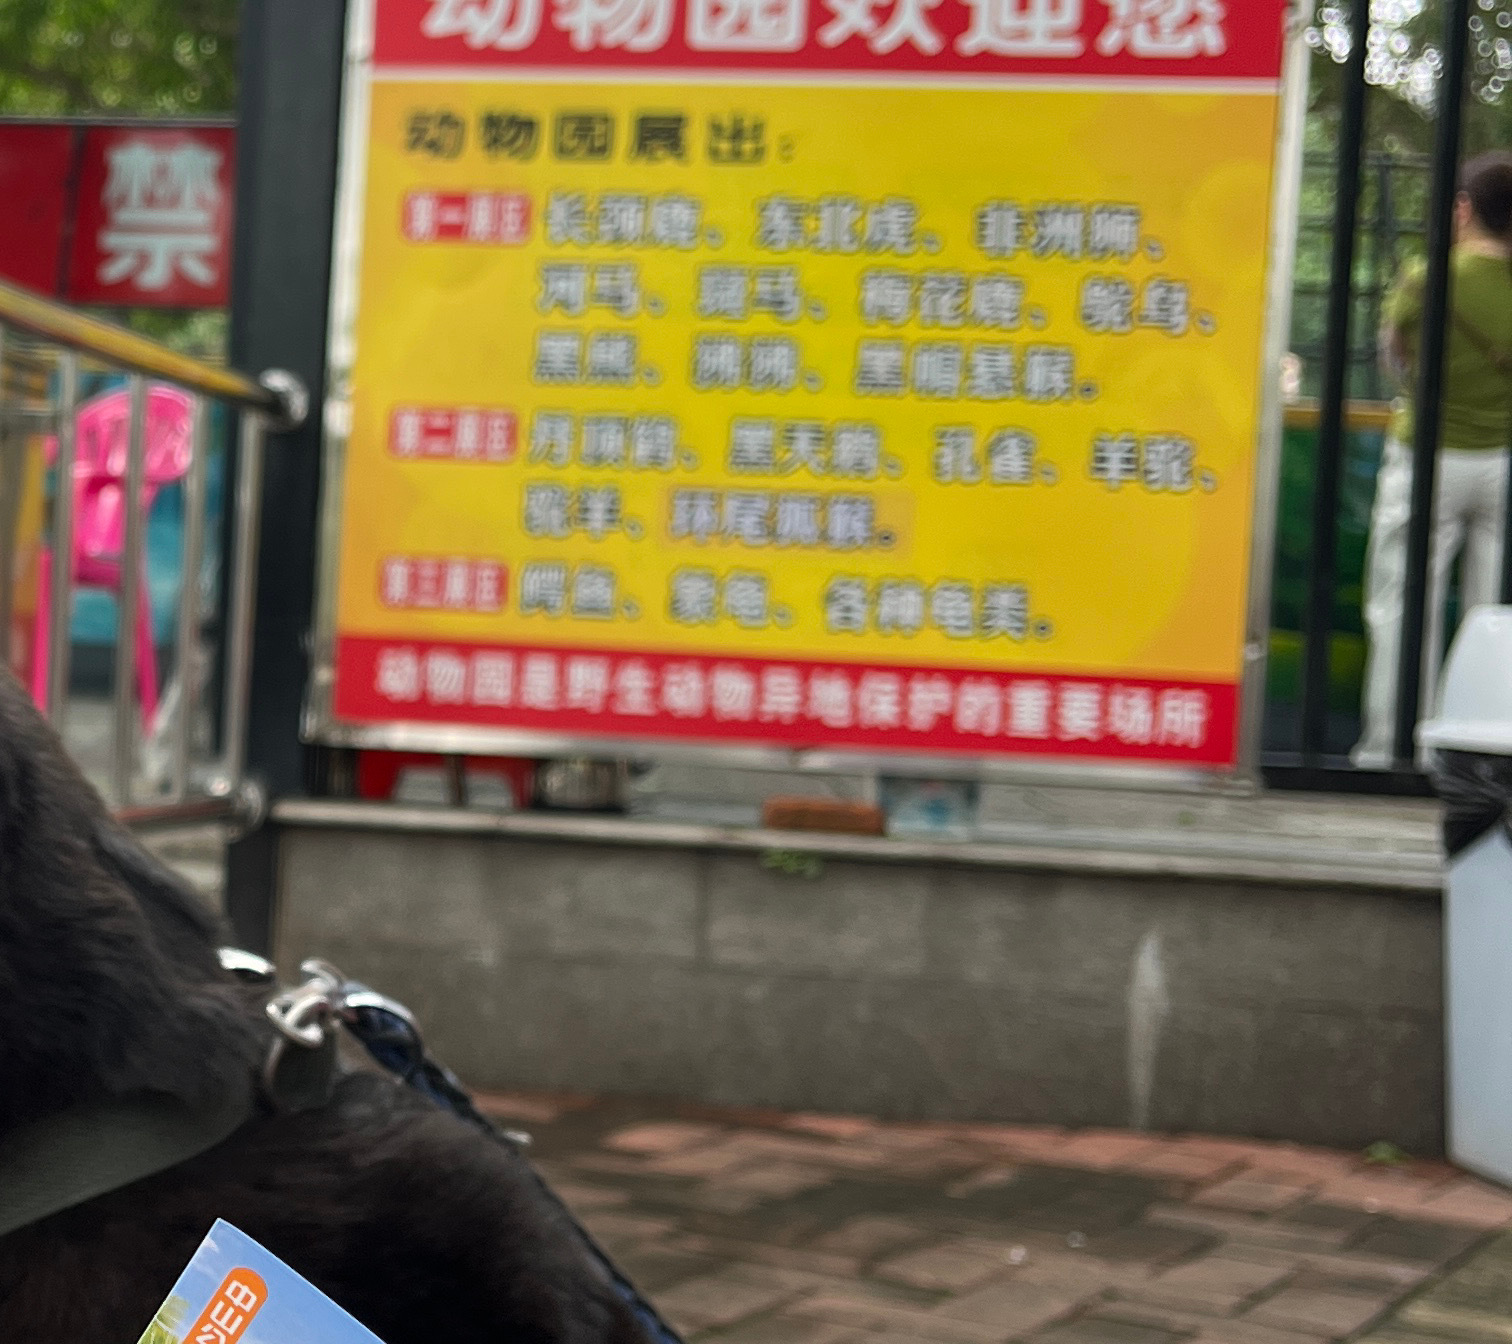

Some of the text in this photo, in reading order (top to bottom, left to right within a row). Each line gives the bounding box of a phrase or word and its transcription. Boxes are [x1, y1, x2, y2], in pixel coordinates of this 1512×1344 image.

[98, 142, 224, 290] 禁
[377, 645, 1211, 748] 动物园是野生动物异地保护的重要场所
